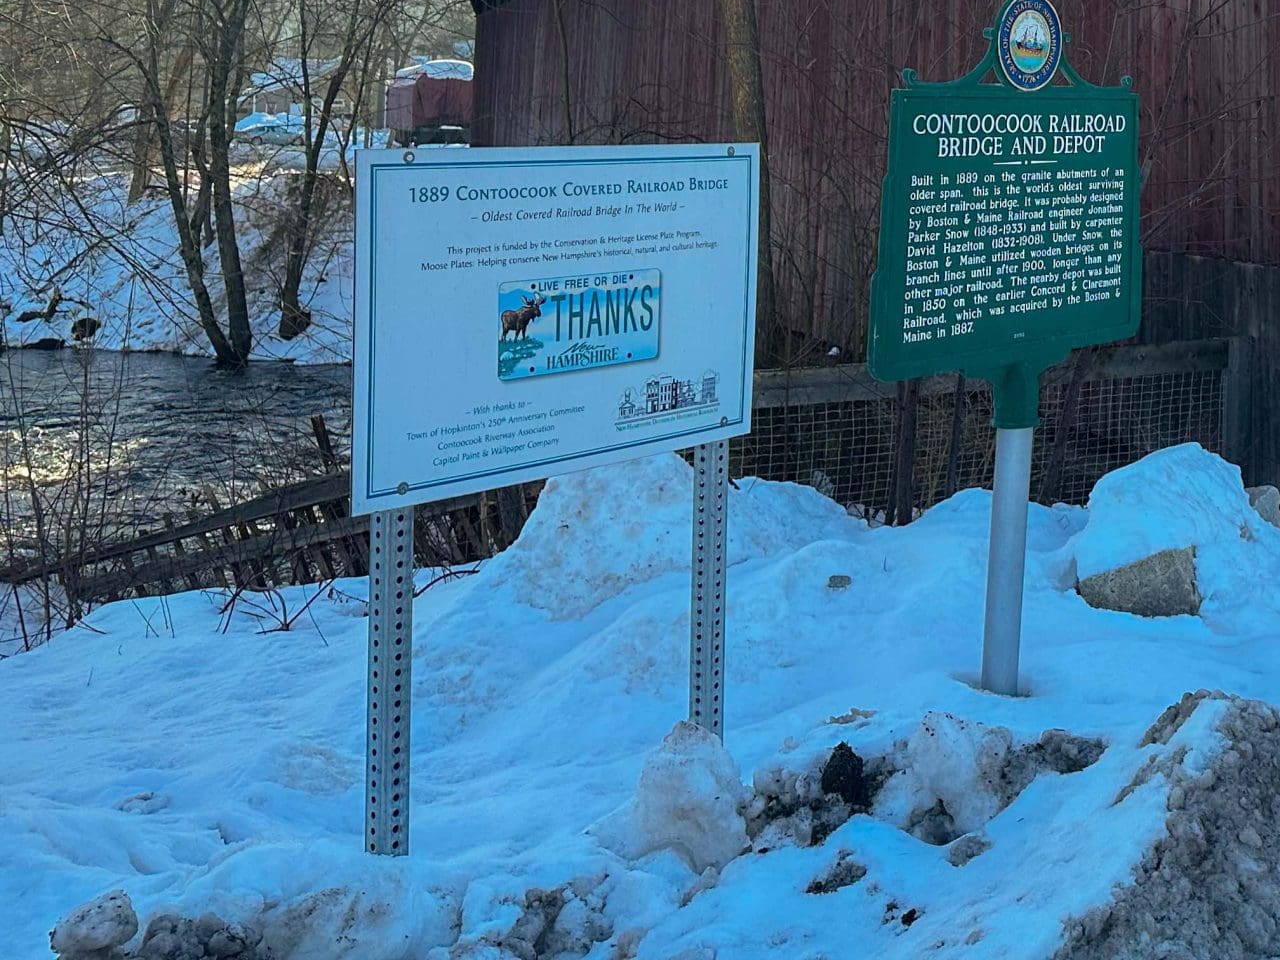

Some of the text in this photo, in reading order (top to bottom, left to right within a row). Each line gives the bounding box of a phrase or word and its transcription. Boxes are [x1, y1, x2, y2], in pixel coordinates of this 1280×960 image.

[913, 113, 1125, 135] CONTOOCOOK RAILROAD
[938, 135, 1106, 157] BRIDGE AND DEPOT
[911, 175, 933, 186] Built
[940, 174, 949, 184] in
[956, 172, 978, 184] 1889
[984, 174, 995, 182] on
[1001, 172, 1016, 182] the
[1021, 170, 1052, 183] granite
[1056, 168, 1097, 179] abutments
[1101, 167, 1109, 177] of
[409, 178, 728, 203] 1889 CONTOOCOOK COVERED RAILROAD BRIDGE
[910, 190, 935, 200] older
[973, 186, 988, 196] this
[994, 185, 1000, 195] is
[1007, 184, 1020, 194] the
[1026, 183, 1054, 193] world's
[1059, 182, 1082, 191] oldest
[1089, 180, 1124, 190] surviving
[482, 202, 677, 222] Oldest Covered Railroad Bridge In The World
[910, 203, 946, 214] covered
[950, 200, 986, 212] railroad
[990, 199, 1019, 210] bridge.
[1024, 197, 1031, 206] It
[1052, 194, 1087, 207] probably
[1090, 192, 1123, 203] designed
[909, 204, 1123, 230] by Boston & Maine Railroad engineer Jonathan
[907, 245, 935, 257] David
[944, 241, 984, 253] Hazelton
[1053, 233, 1076, 242] Under
[1110, 228, 1122, 237] the
[908, 217, 1123, 243] Parker Snow (1848-1933) and built by carpenter
[447, 246, 463, 254] This
[466, 245, 491, 255] project
[502, 243, 527, 251] funded
[554, 238, 597, 247] Conservation
[608, 235, 635, 243] Heritage
[637, 232, 658, 241] License
[478, 258, 507, 267] Helping
[561, 250, 601, 260] Hampshire's
[659, 244, 670, 252] and
[672, 242, 694, 251] cultural
[907, 260, 938, 271] Boston
[945, 256, 952, 267] &
[960, 254, 986, 265] Maine
[991, 249, 1025, 262] utilized
[1031, 247, 1061, 257] wooden
[1066, 244, 1094, 254] bridges
[1114, 241, 1122, 249] its
[906, 272, 940, 285] branch
[944, 270, 965, 281] lines
[971, 266, 991, 278] until
[996, 264, 1018, 275] after
[1053, 258, 1079, 269] longer
[1085, 255, 1101, 264] than
[1108, 253, 1121, 262] any
[539, 274, 627, 292] LIVE FREE OR DIE
[905, 288, 931, 300] other
[935, 284, 963, 296] major
[1011, 276, 1027, 286] The
[1031, 273, 1059, 284] nearby
[1063, 269, 1084, 280] depot
[1088, 268, 1102, 276] was
[1105, 264, 1121, 274] built
[904, 277, 1121, 314] in 1850 on the earlier Concord & Claremont
[956, 308, 982, 320] which
[989, 306, 1005, 315] was
[1010, 299, 1047, 313] acquired
[1053, 297, 1062, 307] by
[1067, 295, 1080, 304] the
[1085, 292, 1110, 301] Boston
[1115, 288, 1120, 298] &
[551, 285, 653, 342] THANKS
[903, 331, 932, 343] Maine
[937, 328, 945, 338] in
[547, 347, 619, 369] HAMPSHIRE
[560, 342, 605, 355] New
[473, 406, 490, 415] With
[493, 402, 516, 412] thanks
[407, 431, 428, 441] Town
[430, 428, 438, 437] of
[441, 421, 486, 435] Hopkinton's
[508, 412, 547, 424] Anniversary
[550, 405, 585, 417] Committee
[438, 424, 555, 451] Contoocook Riverway Association
[433, 454, 459, 467] Capitol
[462, 452, 480, 461] Paint
[491, 444, 525, 456] Wallpaper
[527, 438, 559, 449] Company
